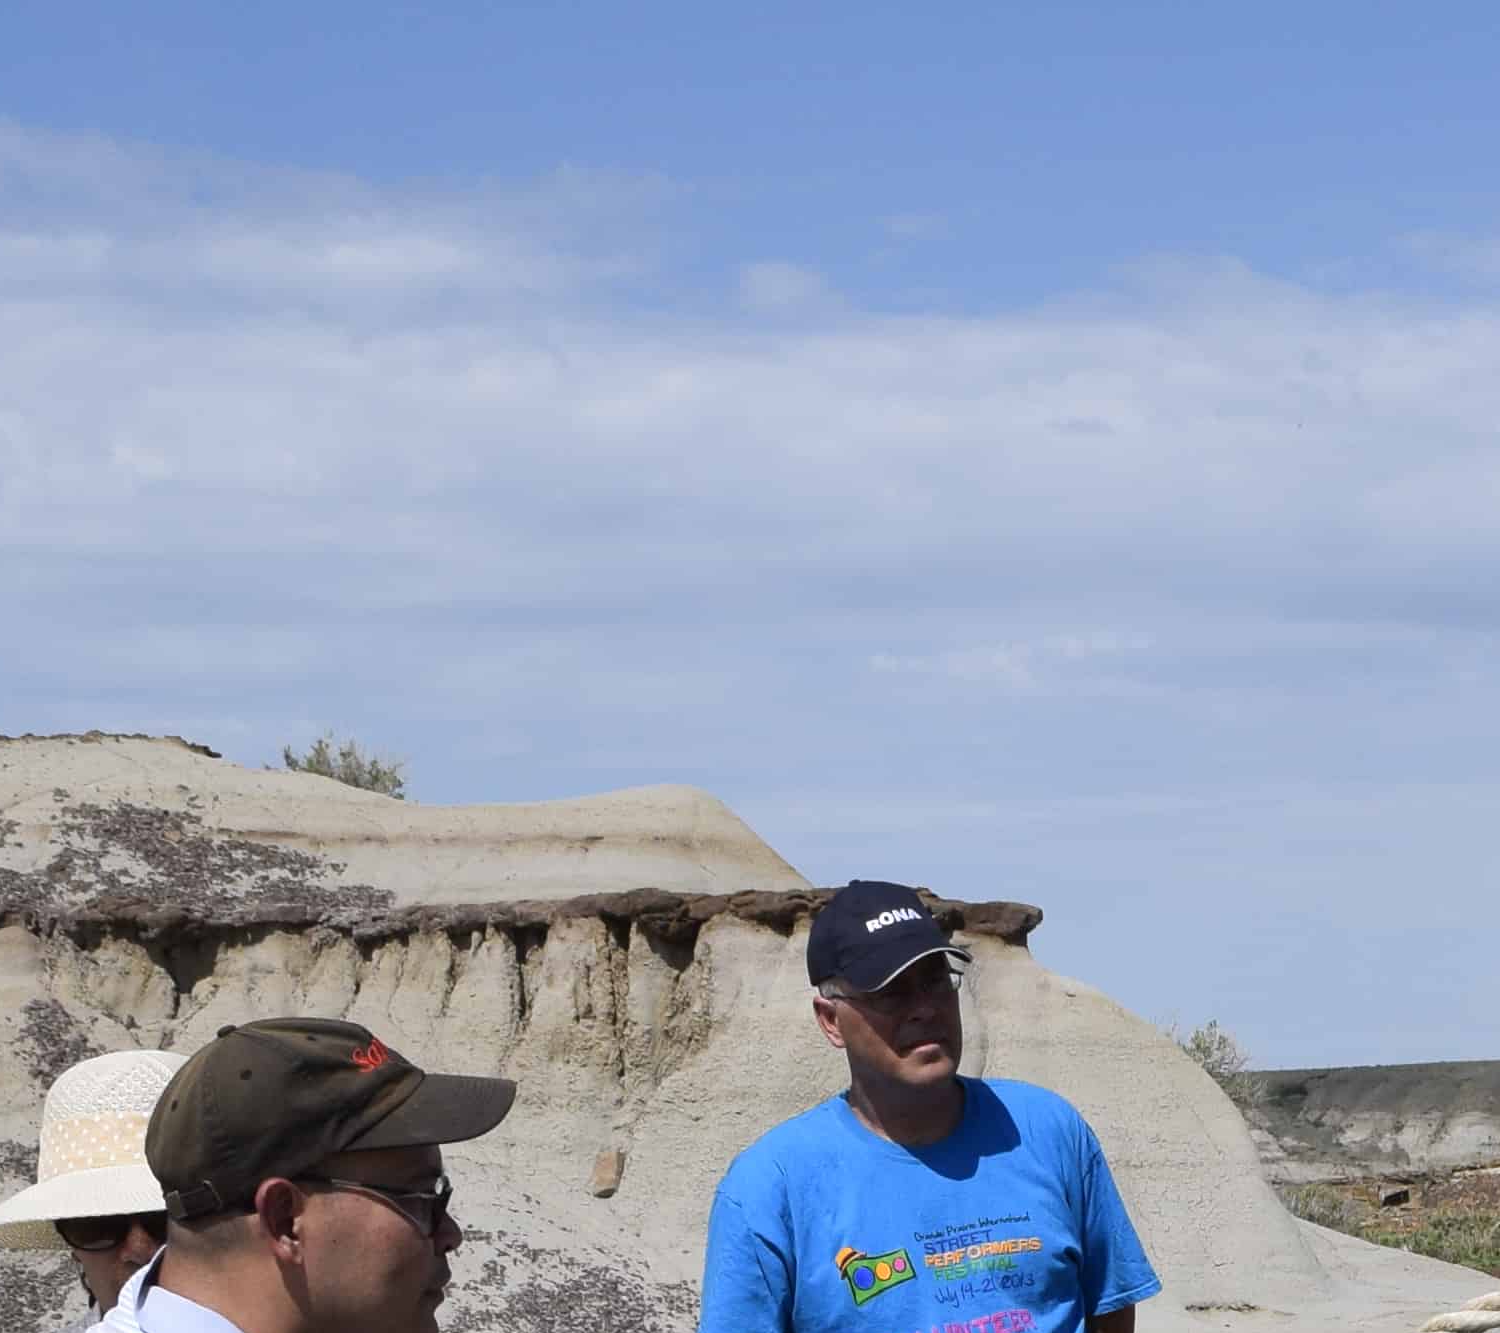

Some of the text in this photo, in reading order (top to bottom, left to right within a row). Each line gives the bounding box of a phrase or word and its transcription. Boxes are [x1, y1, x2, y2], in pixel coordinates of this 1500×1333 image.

[866, 908, 922, 932] RONA
[924, 1229, 993, 1255] STREET
[924, 1237, 1042, 1268] PERFORMERS
[934, 1256, 1018, 1281] FESTIVAL
